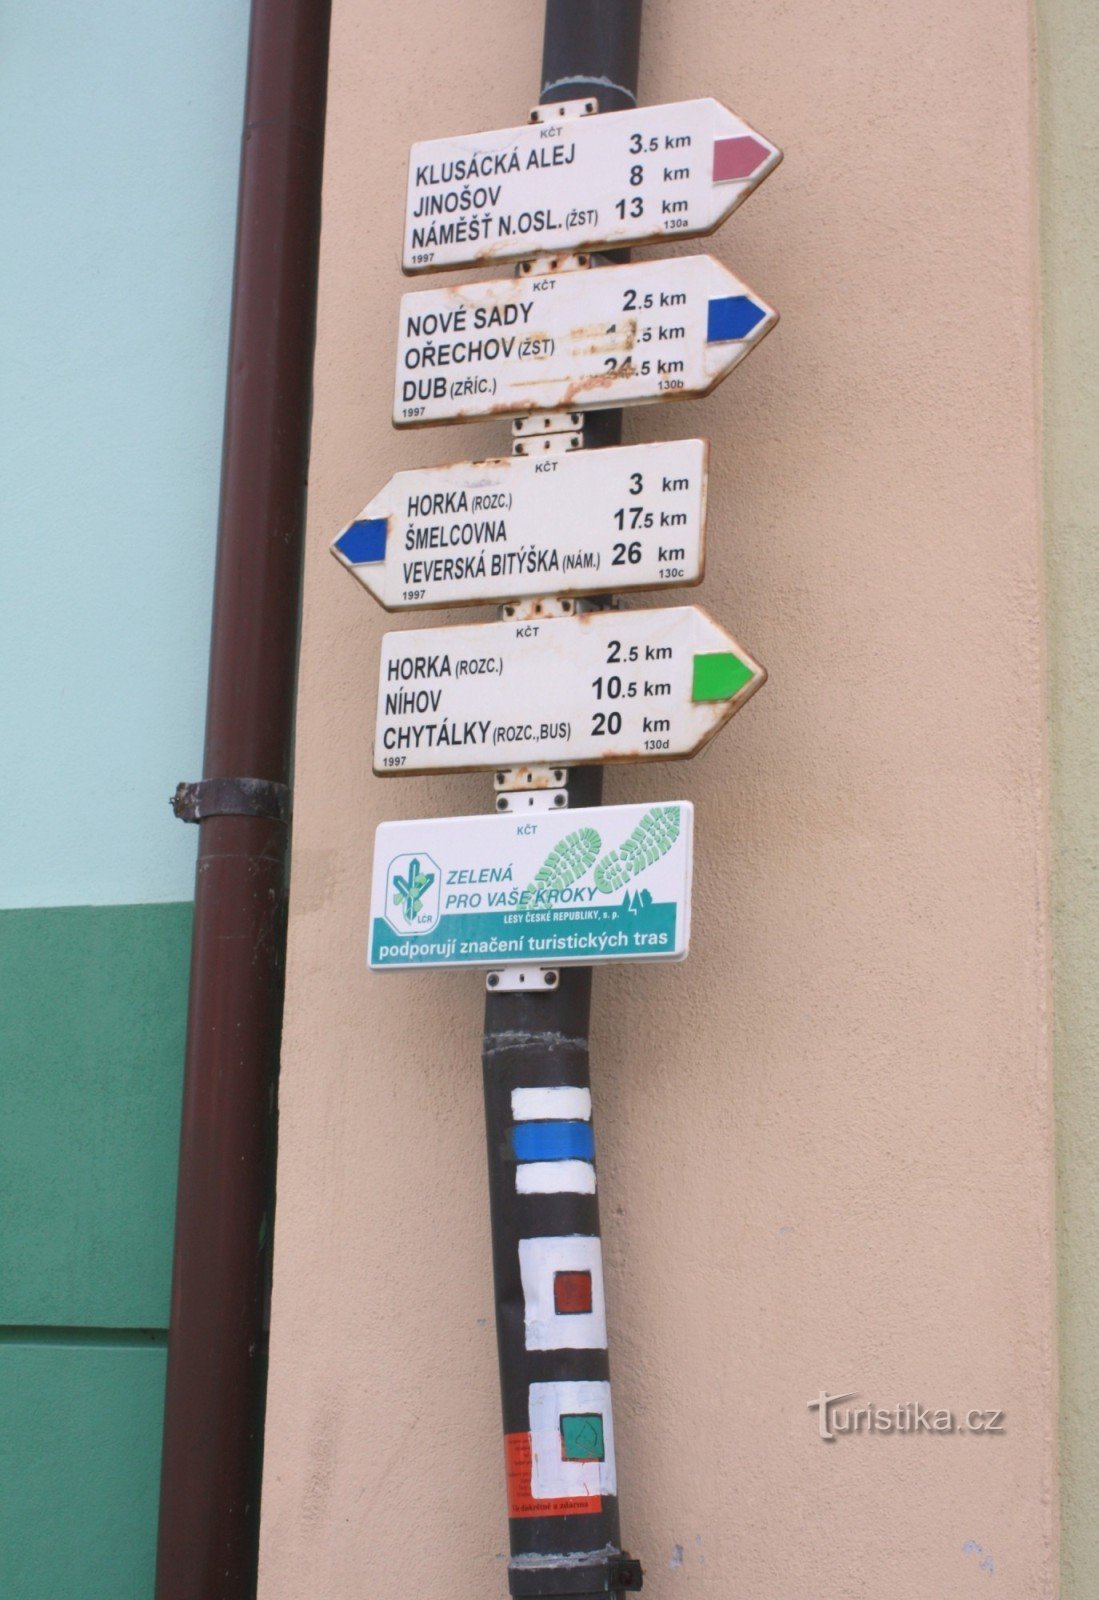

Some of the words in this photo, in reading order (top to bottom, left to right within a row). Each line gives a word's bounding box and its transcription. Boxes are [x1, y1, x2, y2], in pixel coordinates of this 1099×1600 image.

[540, 127, 563, 139] KČT
[629, 134, 658, 154] 3.5
[665, 134, 692, 149] km
[416, 149, 521, 187] KLUSÁCKÁ
[526, 143, 576, 169] ALEJ
[630, 166, 643, 185] 8
[663, 166, 690, 182] km
[413, 185, 502, 217] JINOŠOV
[615, 198, 644, 219] 13
[661, 200, 689, 214] km
[411, 215, 493, 249] NÁMĚŠŤ
[499, 210, 563, 236] N.OSL.
[565, 209, 599, 231] (ŽST)
[664, 219, 689, 229] 130a
[411, 253, 434, 264] 1997
[533, 280, 556, 292] KČT
[622, 289, 653, 311] 2.5
[660, 292, 686, 307] km
[407, 305, 467, 338] NOVÉ
[473, 302, 534, 329] SADY
[659, 326, 685, 341] km
[405, 336, 516, 369] OŘECHOV
[518, 338, 555, 359] (ŽST)
[657, 360, 684, 374] km
[402, 377, 447, 402] DUB
[450, 375, 497, 400] (ZŘÍC.)
[658, 380, 684, 390] 130b
[402, 407, 425, 418] 1997
[535, 462, 558, 473] KČT
[629, 473, 643, 495] 3
[662, 476, 689, 493] km
[408, 491, 468, 517] HORKA
[472, 493, 513, 513] (ROZC.)
[613, 507, 653, 531] 17.5
[660, 511, 687, 527] km
[405, 520, 507, 551] ŠMELCOVNA
[403, 549, 487, 584] VEVERSKÁ
[490, 544, 559, 577] BITÝŠKA
[562, 551, 600, 572] (NÁM.)
[611, 542, 642, 567] 26
[658, 546, 685, 562] km
[658, 567, 684, 579] 130c
[403, 589, 426, 600] 1997
[515, 626, 539, 638] KČT
[606, 641, 639, 664] 2.5
[645, 644, 673, 661] km
[388, 655, 452, 682] HORKA
[455, 658, 503, 679] (ROZC.)
[592, 676, 638, 700] 10.5
[643, 680, 671, 697] km
[385, 687, 442, 716] NÍHOV
[383, 715, 491, 750] CHYTÁLKY
[591, 712, 622, 736] 20
[643, 717, 671, 733] km
[644, 738, 670, 751] 130d
[383, 756, 406, 767] 1997
[516, 824, 538, 836] KČT
[446, 864, 513, 884] ZELENÁ
[446, 894, 481, 909] PRO
[488, 887, 531, 907] VAŠE
[535, 887, 598, 906] KROKY
[504, 912, 524, 924] LESY
[525, 910, 551, 923] ČESKÉ
[554, 910, 601, 922] REPUBLIKY,
[379, 939, 456, 960] podporují
[460, 938, 524, 955] značení
[528, 931, 630, 952] turistických
[634, 931, 668, 946] tras
